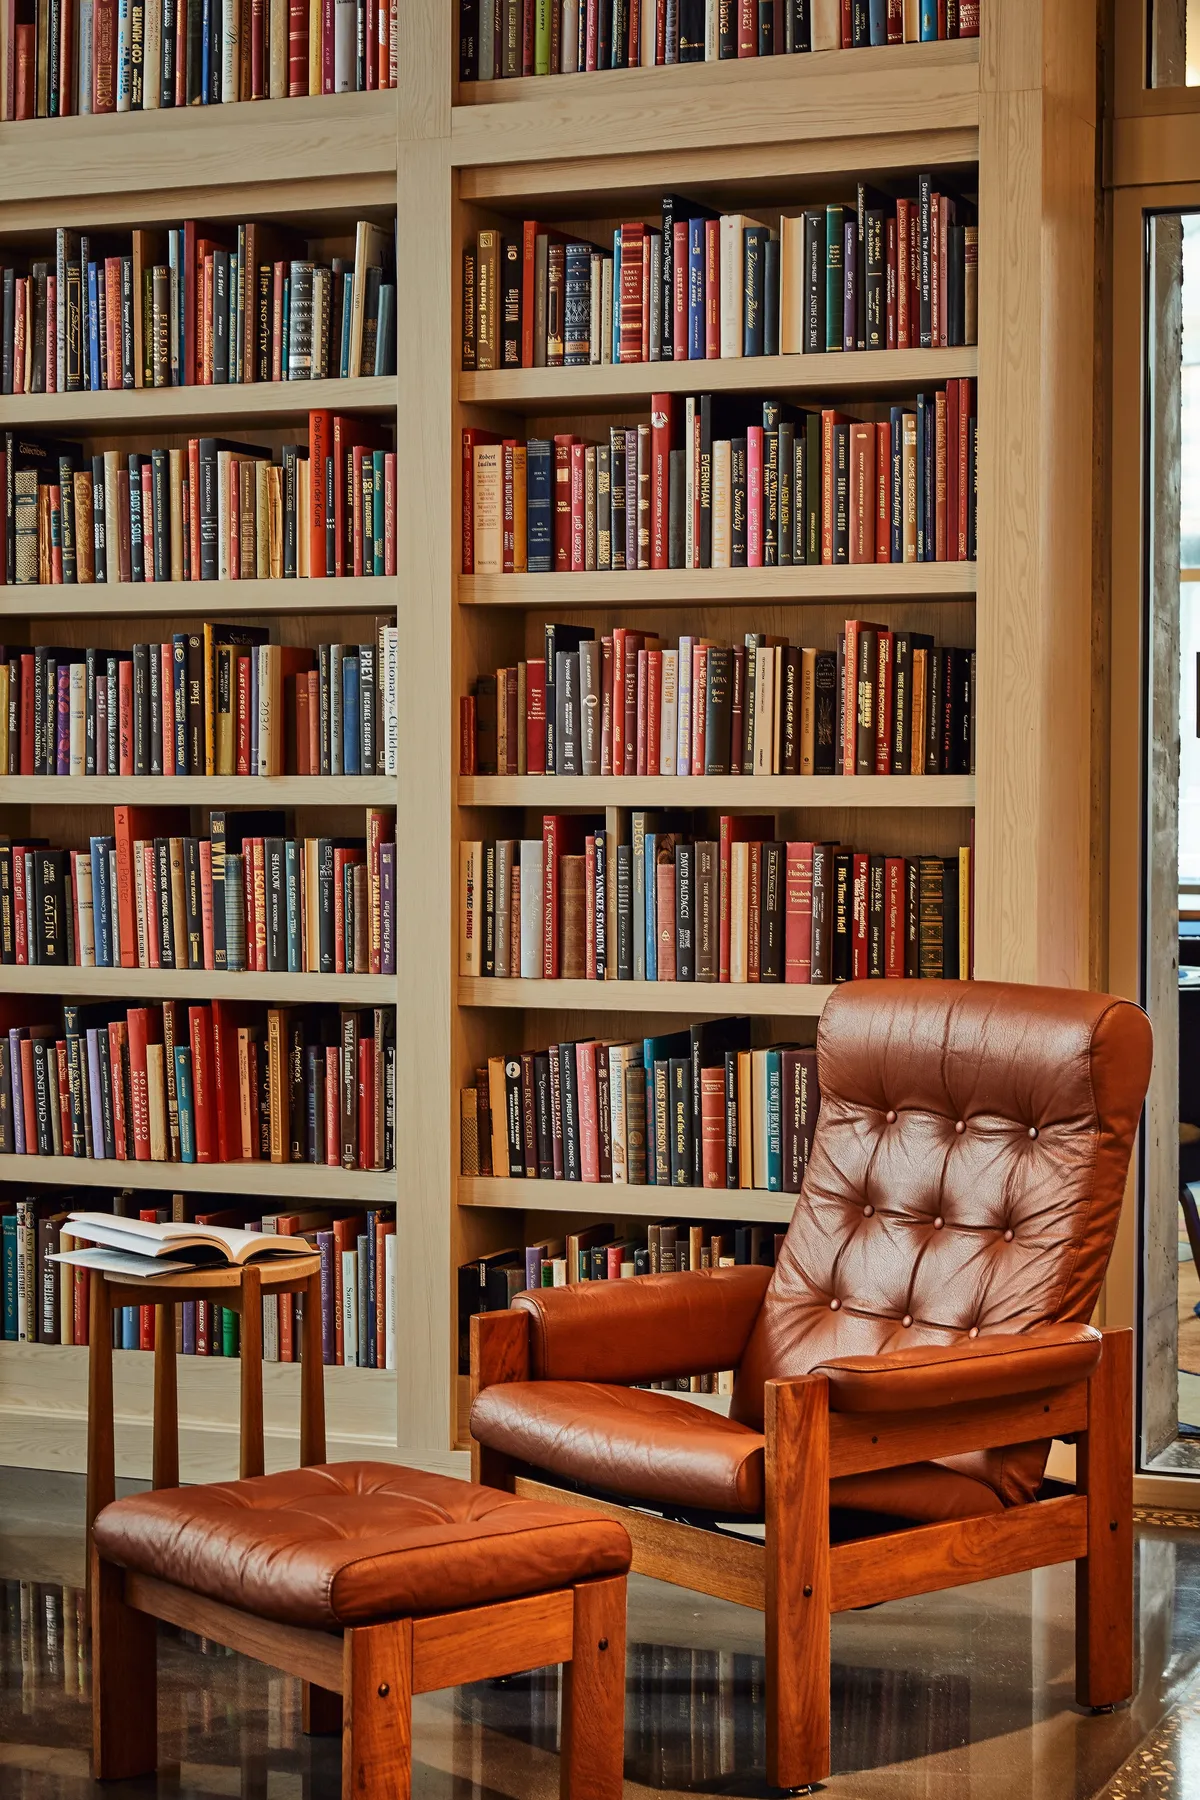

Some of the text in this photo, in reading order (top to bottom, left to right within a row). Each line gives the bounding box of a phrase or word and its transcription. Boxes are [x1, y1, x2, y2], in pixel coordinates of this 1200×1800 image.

[131, 6, 142, 63] COP HUNTER
[742, 8, 752, 30] PREY
[663, 256, 671, 282] Weeping?
[465, 256, 473, 337] JAMES PATTERSON
[505, 289, 518, 321] Wild Fire
[810, 318, 817, 328] TO
[314, 416, 322, 432] Das
[314, 434, 322, 478] Automobil
[936, 399, 945, 502] Jane Fonda's Workout Book
[628, 443, 636, 526] KARMA CHARMER
[701, 454, 709, 507] EVERNHAM
[769, 471, 777, 479] &
[130, 490, 140, 512] BODY
[314, 489, 322, 502] der
[733, 489, 744, 531] Someday
[314, 504, 323, 527] Kunst
[132, 523, 141, 545] SOUL
[361, 651, 373, 682] PREY
[386, 638, 397, 707] Dictionary
[665, 656, 675, 704] METALTOWN
[190, 680, 199, 705] Hotel
[363, 692, 371, 721] MICHAEL
[583, 694, 598, 707] Q
[260, 701, 269, 731] 2034
[388, 716, 398, 769] Children
[634, 819, 643, 855] DEGAS
[15, 856, 23, 900] citizen girl
[118, 838, 129, 904] Gary Panter
[211, 841, 225, 880] WWII
[814, 853, 824, 887] Nomad
[372, 874, 380, 906] PEARL
[680, 852, 689, 918] DAVID BALDACCI
[858, 874, 866, 900] Always
[874, 867, 882, 892] Marley
[44, 895, 54, 938] GAI-JIN
[254, 870, 265, 948] ESCAPE CIA
[596, 874, 604, 953] YANKEE STADIUM
[837, 868, 846, 933] His Time in Hell
[875, 900, 882, 912] Me
[858, 901, 866, 938] Something
[294, 1046, 302, 1082] America's
[344, 1020, 354, 1084] Wild Animals
[36, 1059, 46, 1122] CHALLENGER
[524, 1088, 532, 1107] ERIC
[657, 1069, 666, 1152] JAMES PATTERSON
[677, 1114, 684, 1122] of
[770, 1072, 779, 1154] THE SOUTH BEACH DIET
[567, 1127, 573, 1138] OF
[320, 1242, 328, 1268] Special
[43, 1273, 54, 1333] BIBLIOMYSTERIES
[345, 1287, 353, 1319] Saroyan
